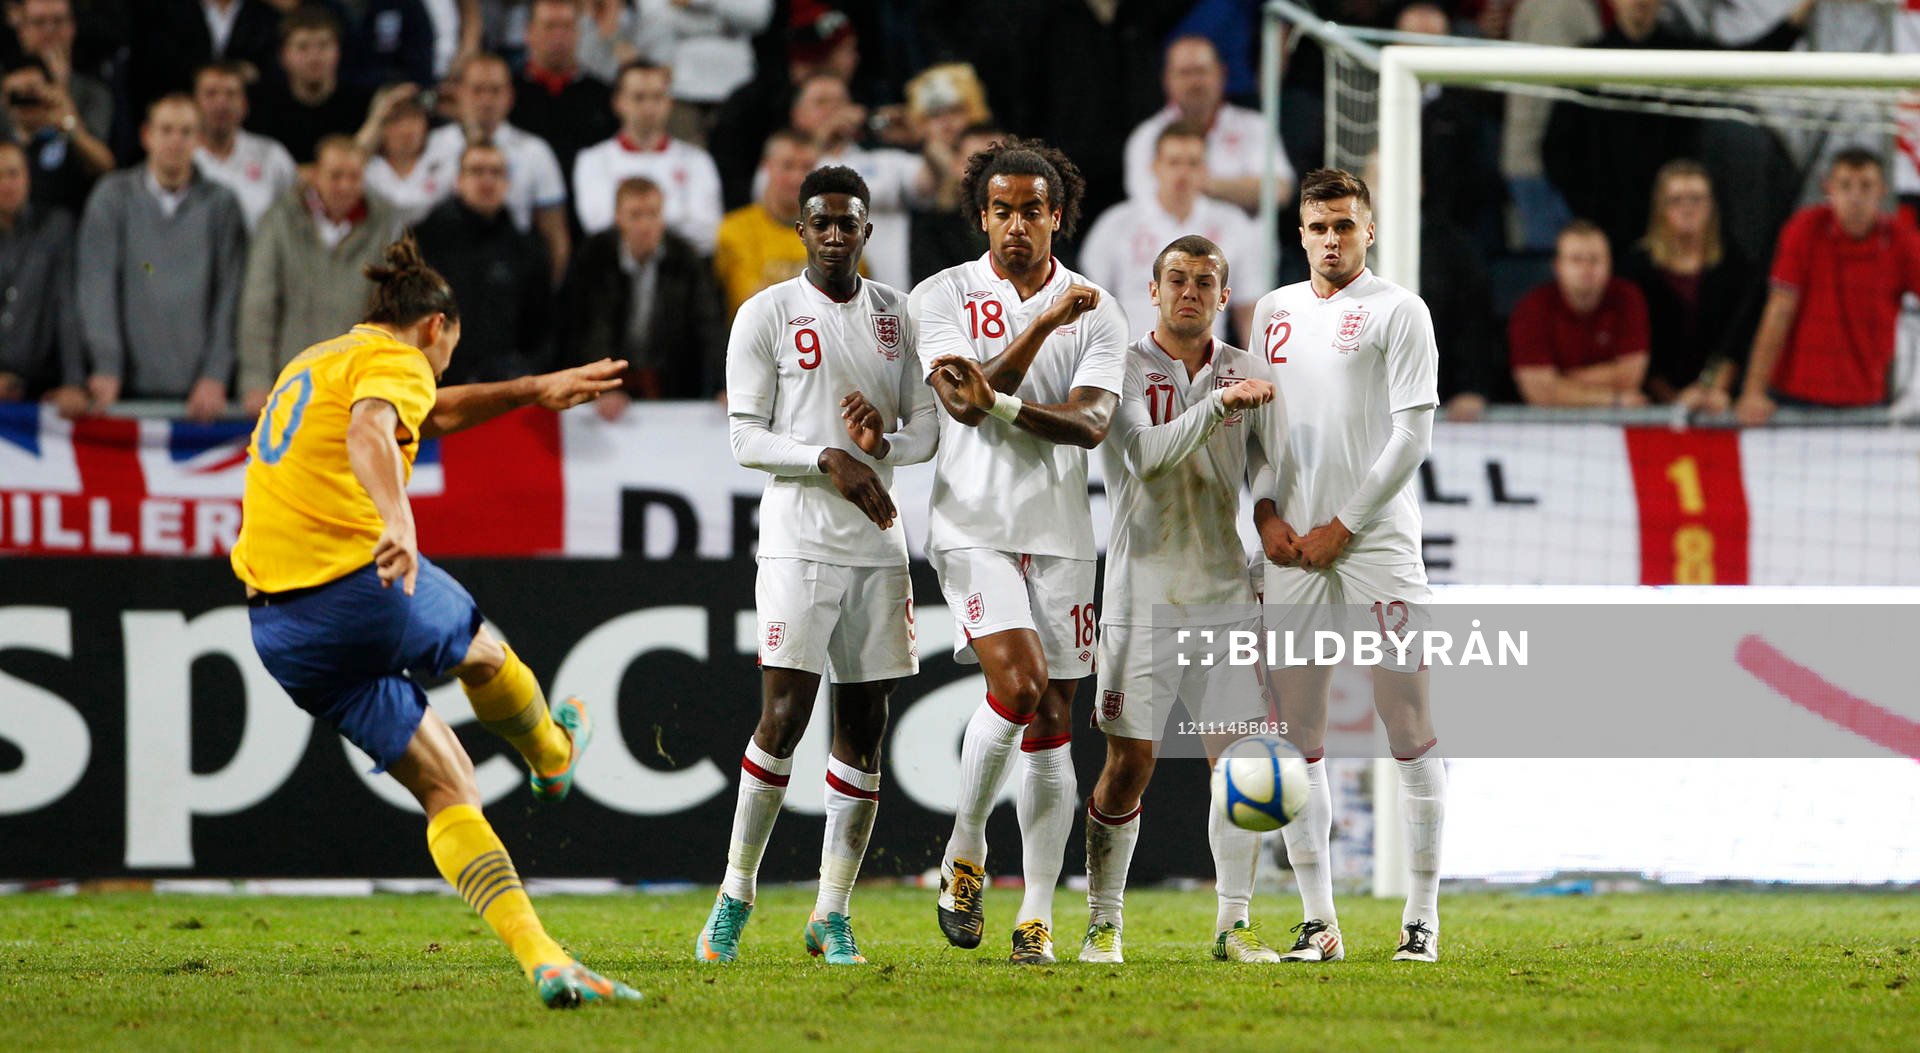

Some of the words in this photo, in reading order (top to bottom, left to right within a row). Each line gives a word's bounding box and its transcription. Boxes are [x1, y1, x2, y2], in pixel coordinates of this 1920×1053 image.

[964, 300, 1005, 339] 18
[795, 328, 822, 370] 9
[1264, 321, 1292, 366] 12
[247, 367, 312, 465] 0
[1146, 384, 1175, 427] 17
[0, 491, 242, 558] ILLER
[1071, 603, 1094, 648] 18
[1370, 600, 1409, 642] 12
